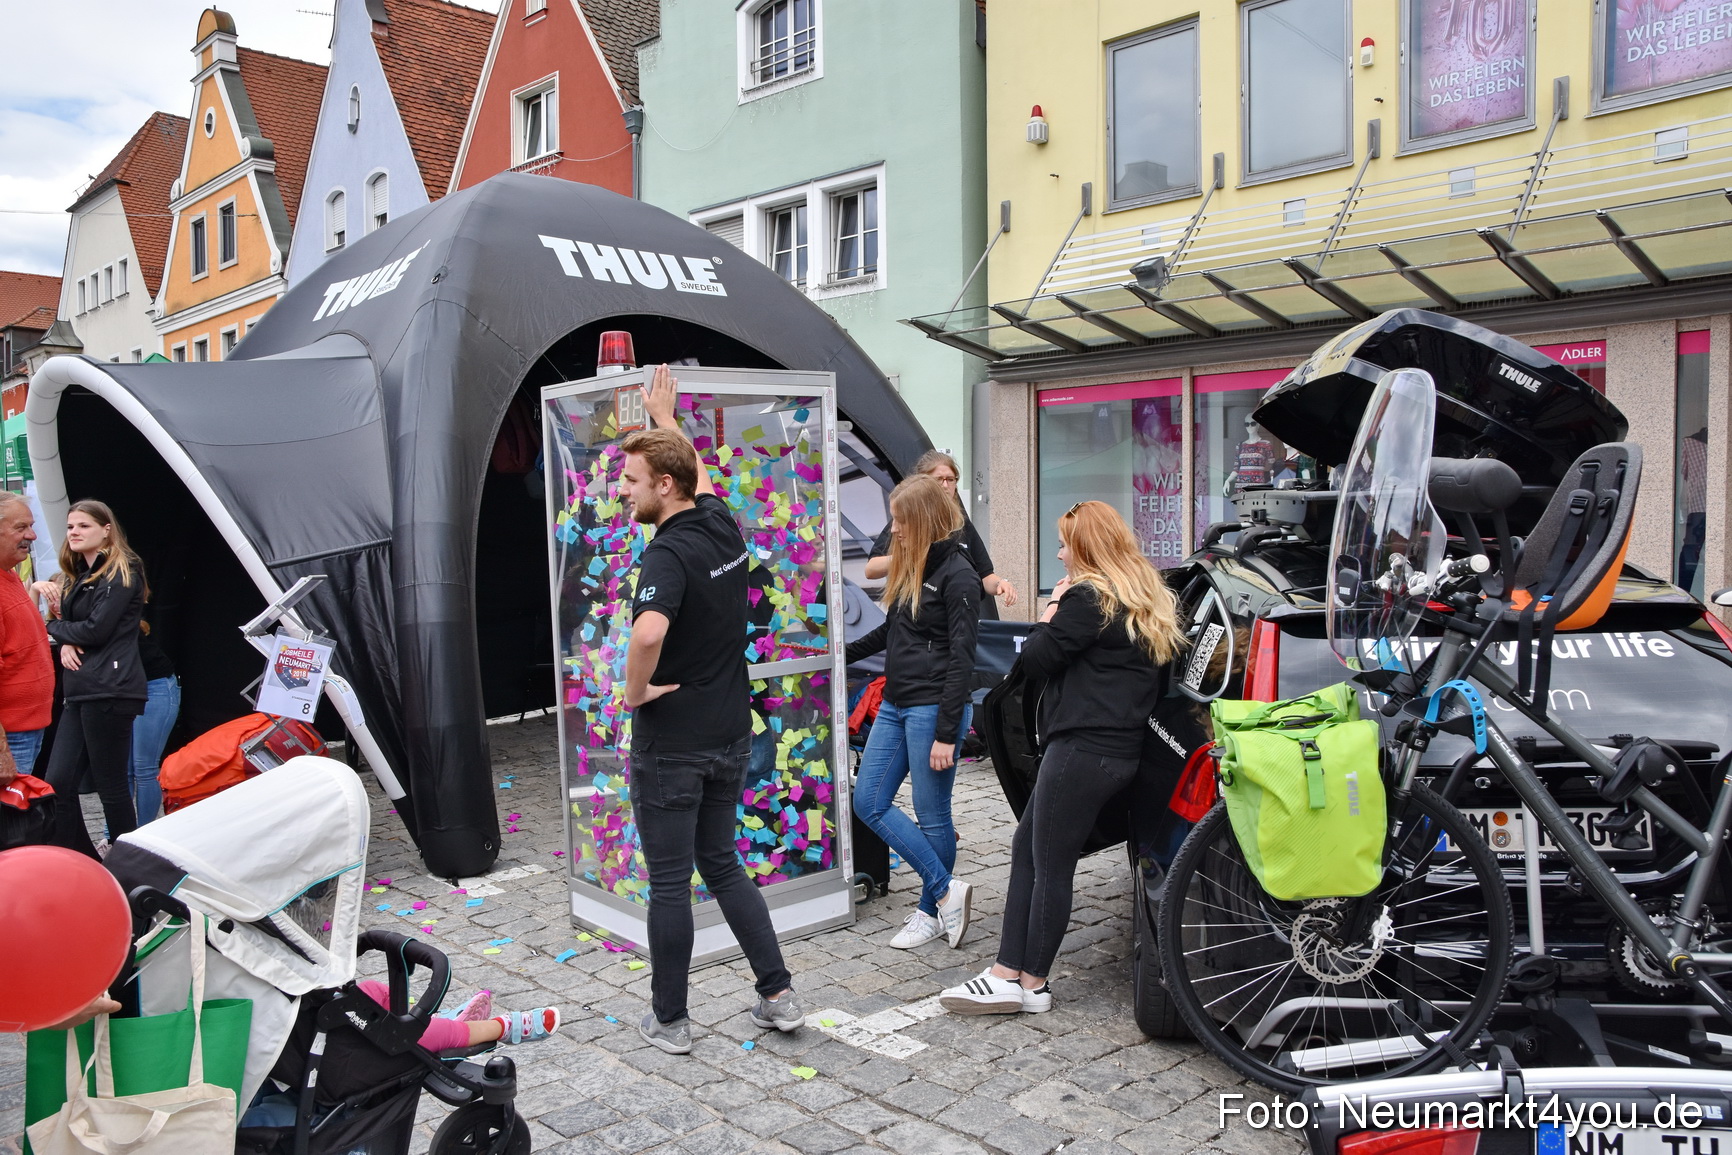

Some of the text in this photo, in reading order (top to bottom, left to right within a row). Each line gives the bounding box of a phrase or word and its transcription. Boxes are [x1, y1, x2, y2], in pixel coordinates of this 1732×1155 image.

[1626, 21, 1666, 43] WIR
[1627, 40, 1668, 62] DAS
[1429, 56, 1525, 90] WIR FEIERN
[1430, 75, 1525, 107] DAS LEBEN.
[680, 282, 720, 292] SWEDEN
[1561, 347, 1602, 361] ADLER
[1499, 362, 1542, 393] THULE
[1154, 518, 1182, 535] DA
[1141, 541, 1197, 557] LEBE
[710, 568, 723, 579] Next
[639, 586, 656, 601] 42
[1601, 632, 1675, 658] life
[278, 655, 312, 669] NEUMARKT
[292, 670, 307, 678] 2018
[302, 703, 311, 714] 8
[1487, 726, 1521, 766] FOCUS
